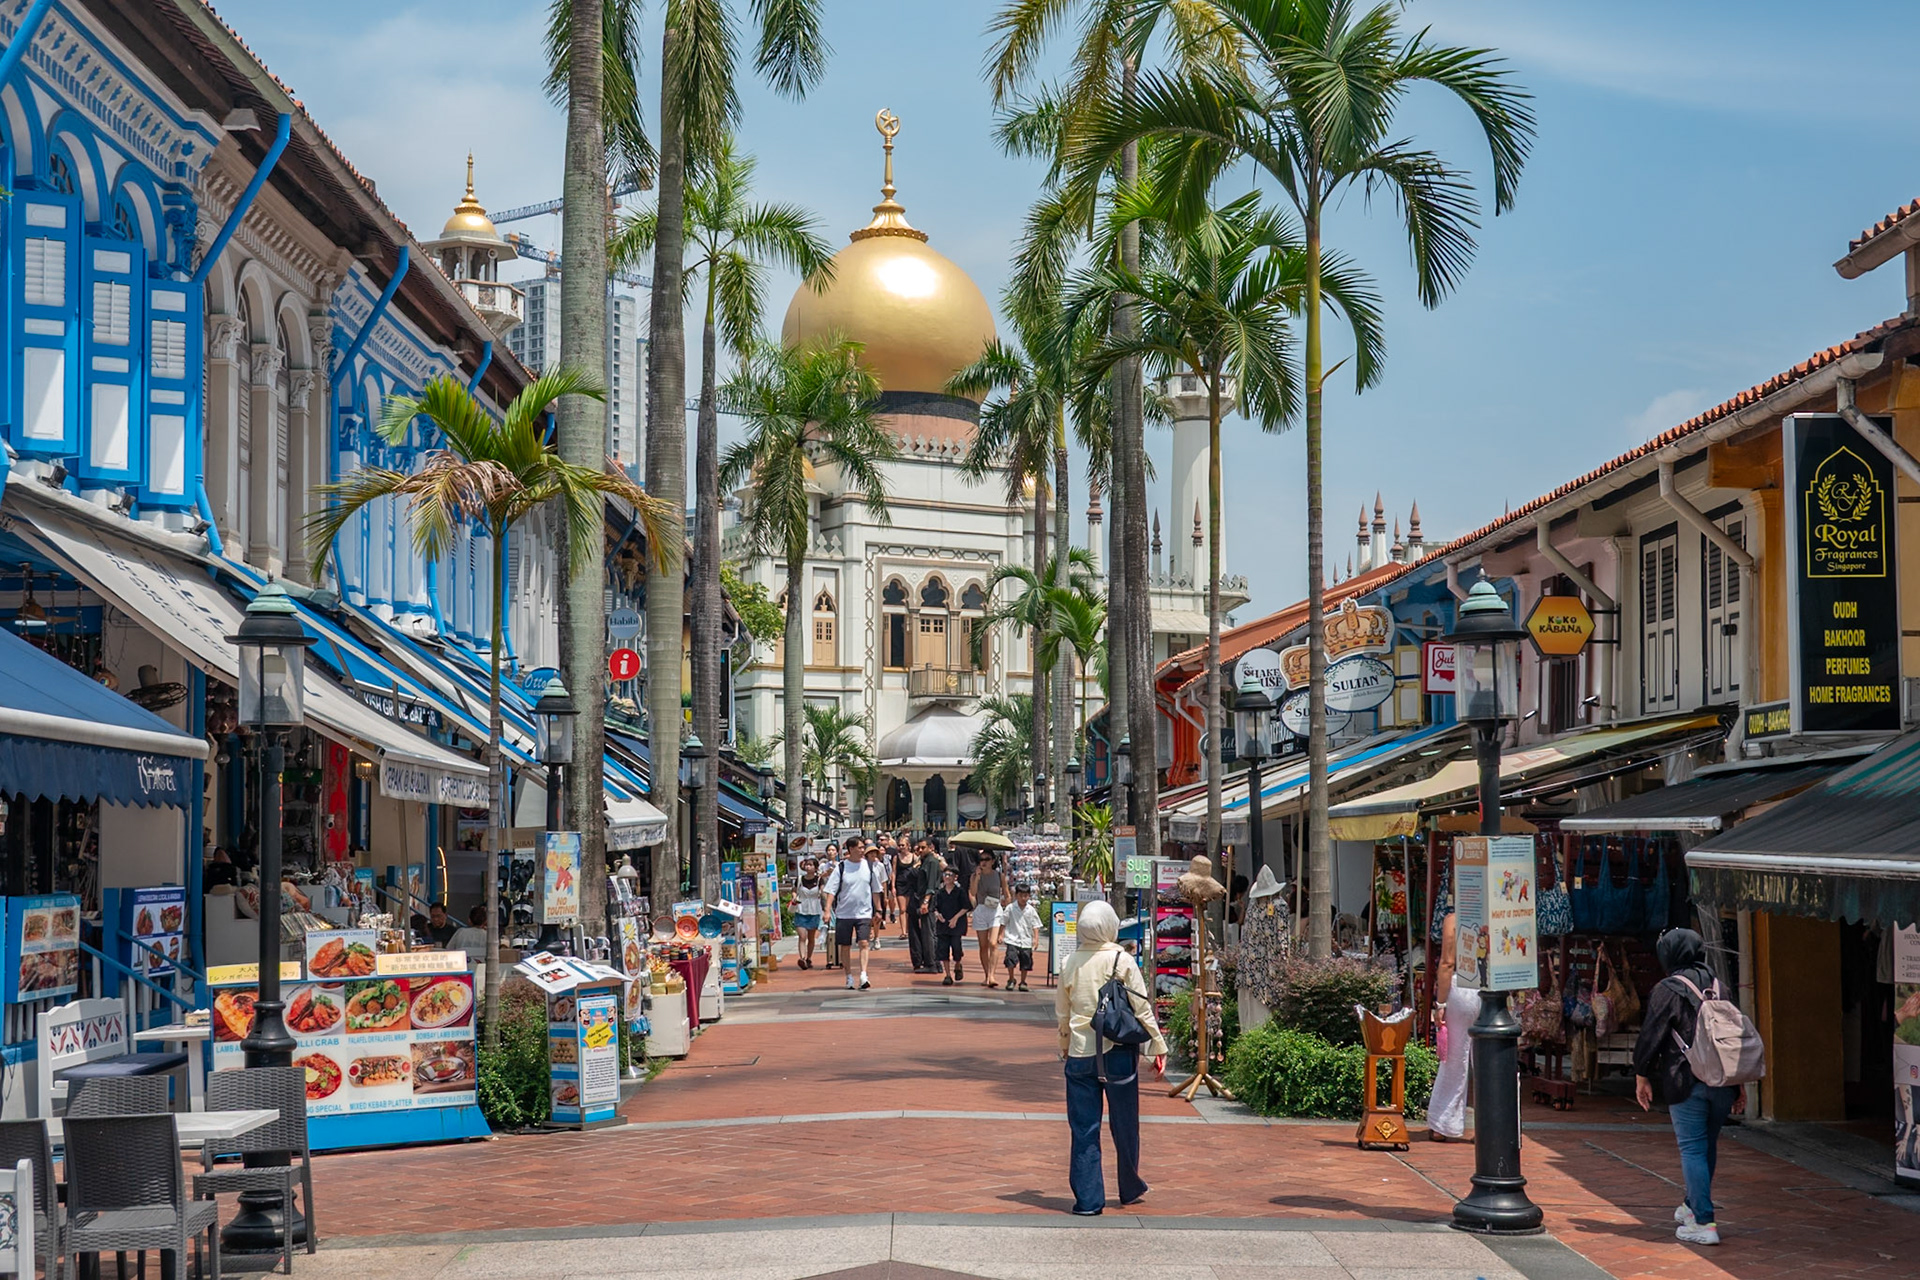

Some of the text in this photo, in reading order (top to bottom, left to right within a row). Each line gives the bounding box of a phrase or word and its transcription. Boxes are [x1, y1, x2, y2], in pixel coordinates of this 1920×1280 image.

[1814, 523, 1876, 549] Royal
[1815, 547, 1878, 562] Fragrances
[1827, 562, 1866, 572] Singapore
[1833, 601, 1858, 619] OUDH
[610, 616, 639, 625] Habibi
[1539, 623, 1583, 635] KABANA
[1824, 629, 1866, 647] BAKHOOR
[1434, 650, 1455, 669] Jul
[1826, 657, 1871, 675] PERFUMES
[1244, 668, 1280, 679] SHAKE
[1260, 677, 1283, 687] USE
[1332, 675, 1379, 693] SULTAN
[1809, 685, 1891, 703] HOME FRAGRANCES
[1748, 713, 1765, 734] OUDH
[556, 897, 568, 906] NO
[348, 1036, 367, 1044] FALAFEL
[374, 1034, 393, 1042] FALAFEL
[394, 1033, 407, 1041] WRAP
[416, 1032, 436, 1040] BOMBAY
[437, 1031, 450, 1039] LAMB
[315, 1038, 339, 1046] CRAB
[215, 1045, 234, 1054] LAMB
[315, 1104, 343, 1113] SPECIAL
[349, 1098, 412, 1110] MIXED KEBAB PLATTER
